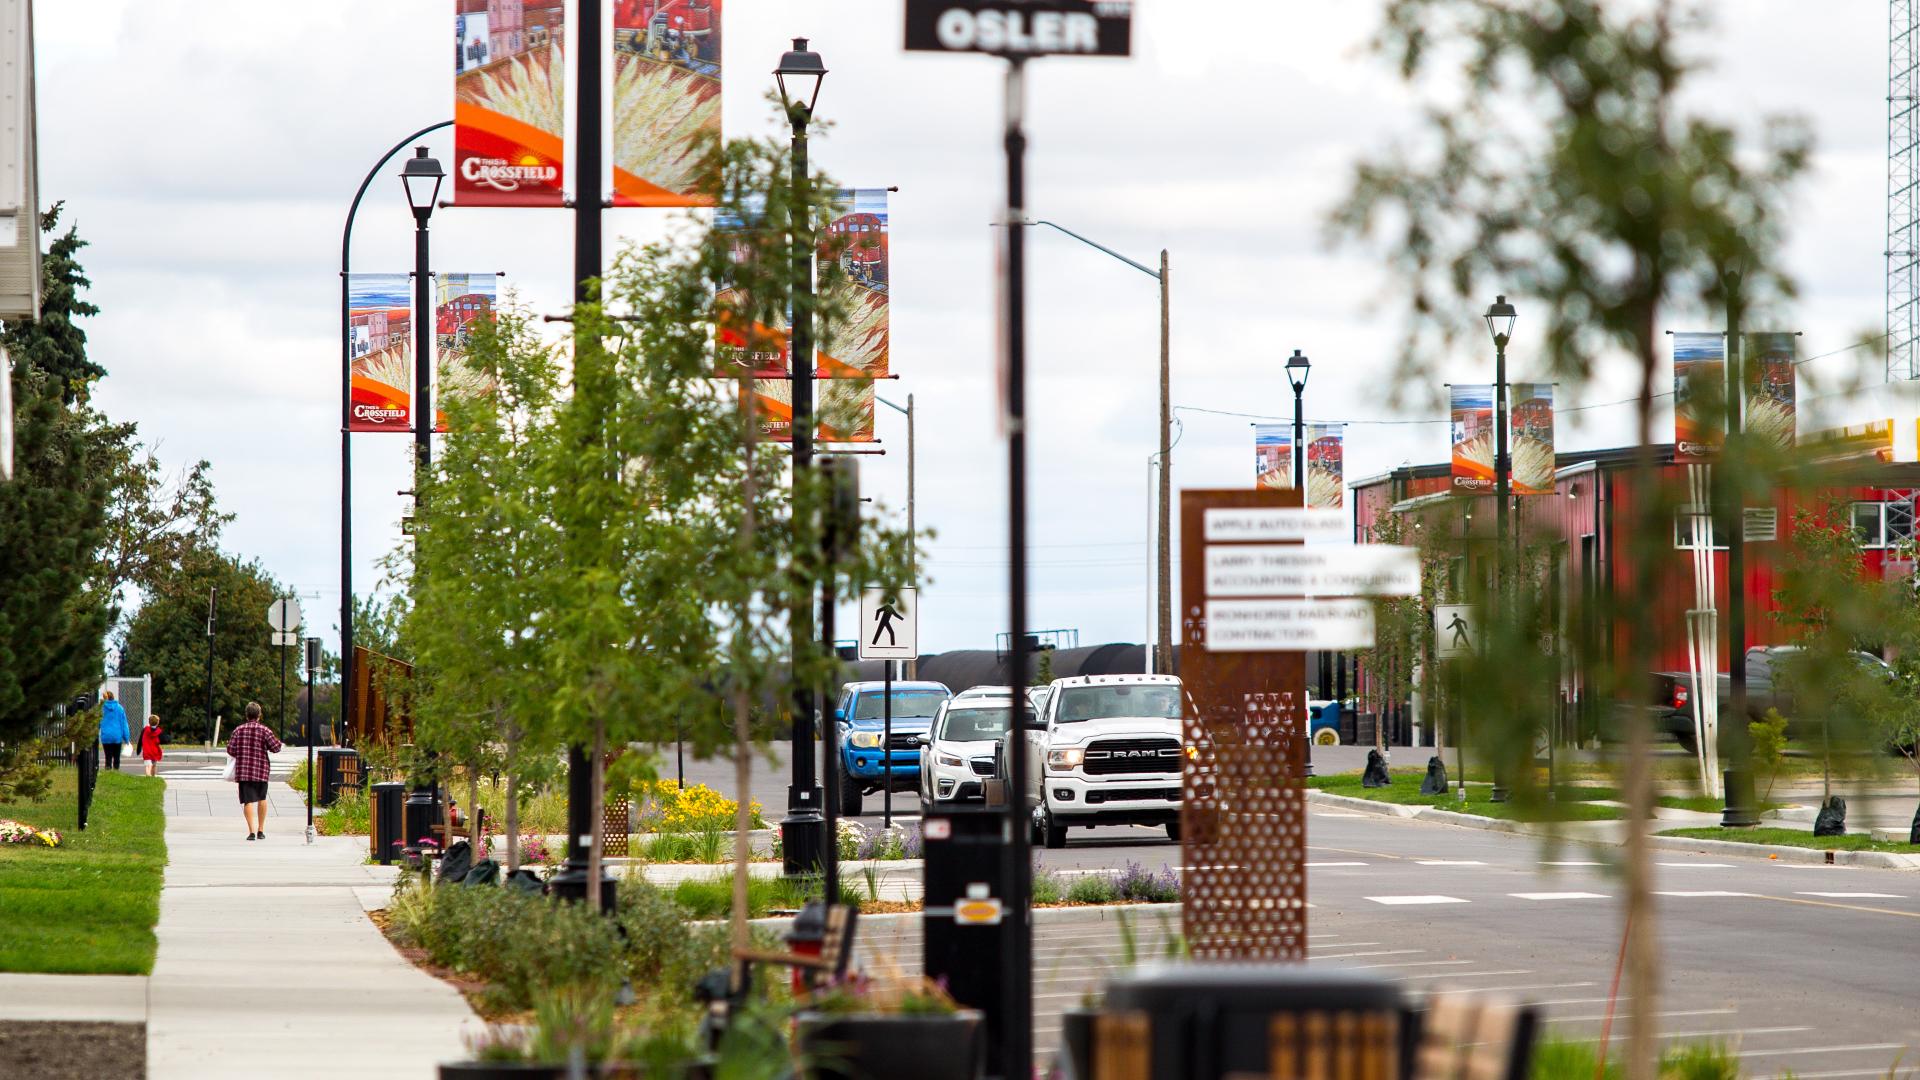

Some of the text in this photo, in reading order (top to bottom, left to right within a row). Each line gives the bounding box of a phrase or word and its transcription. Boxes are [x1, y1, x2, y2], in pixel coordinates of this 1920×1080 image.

[936, 8, 1098, 53] OSLER
[481, 158, 499, 166] THIS
[461, 157, 558, 190] CROSSFIELD
[353, 405, 406, 422] CROSSFIELD
[1213, 517, 1252, 530] APPLE
[1259, 517, 1297, 530] AUTO
[1213, 554, 1254, 567] LARRY
[1213, 574, 1304, 587] ACCOUNTING
[1298, 608, 1368, 621] RAILROAD
[1213, 628, 1317, 641] CONTRACTORS
[1113, 750, 1155, 758] RAM
